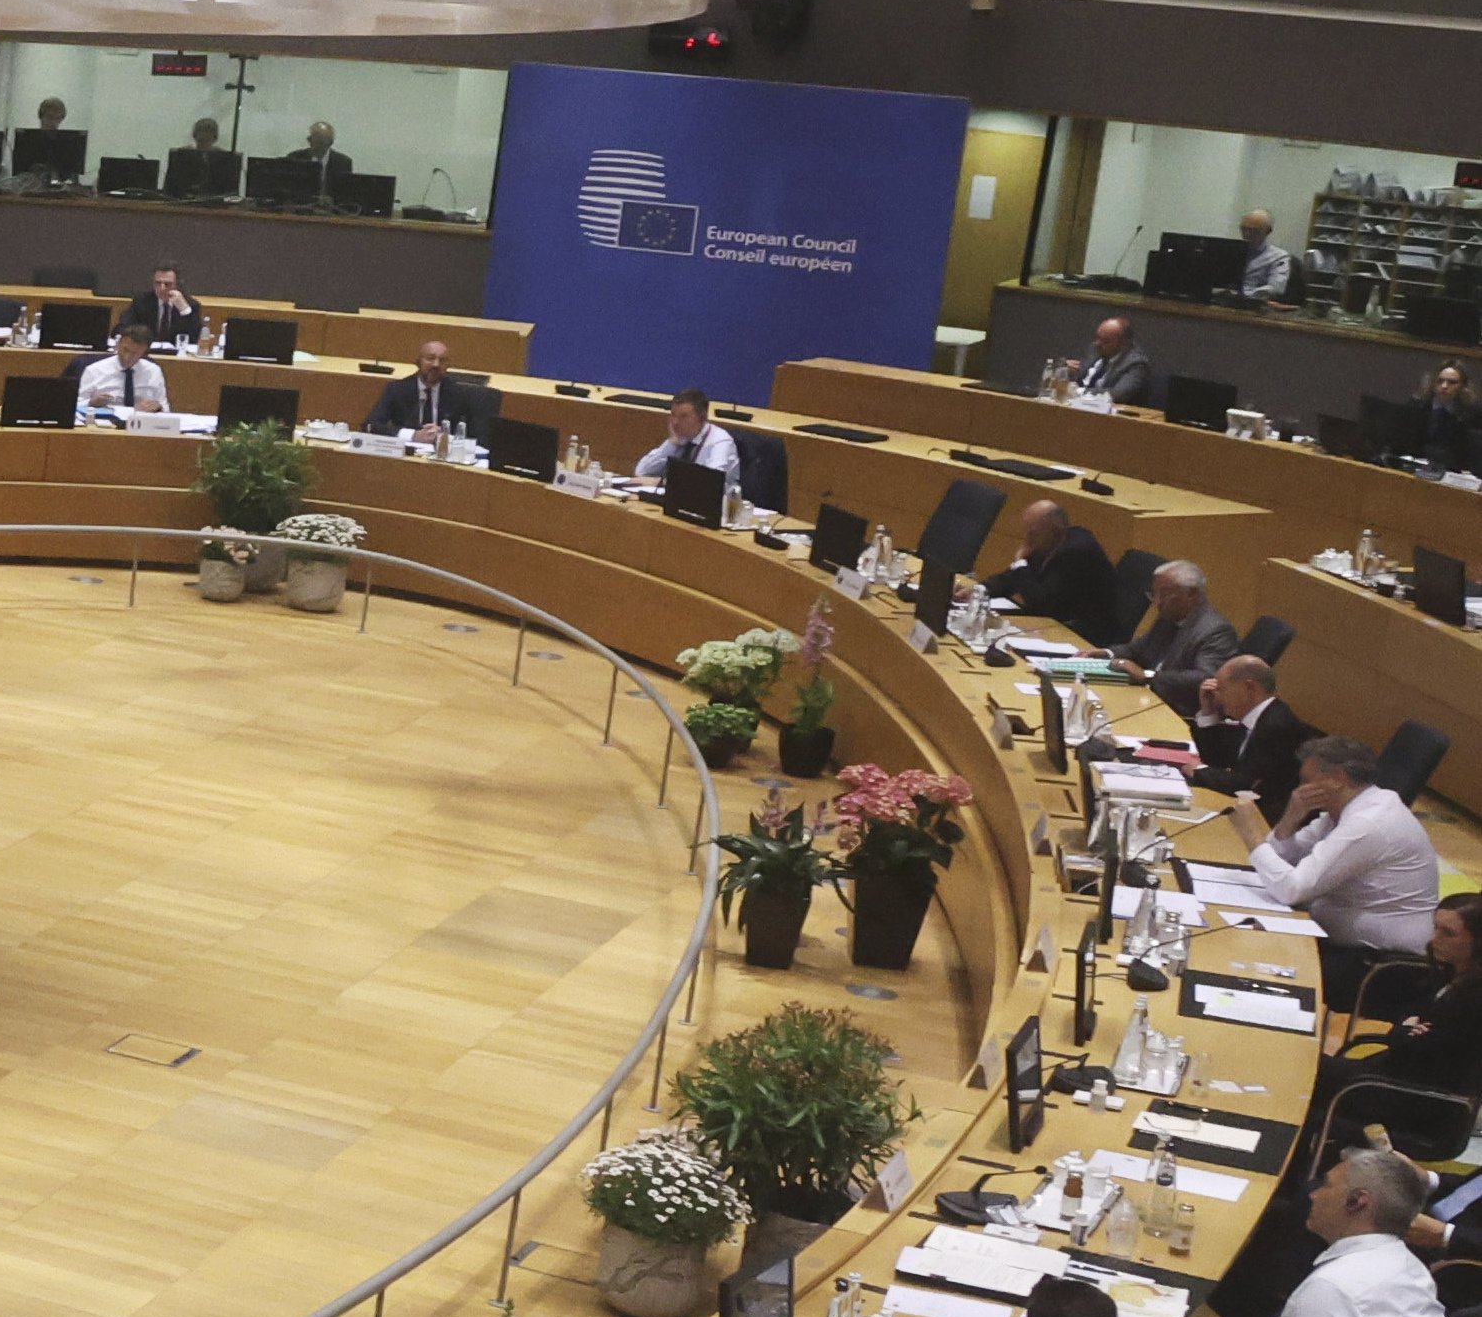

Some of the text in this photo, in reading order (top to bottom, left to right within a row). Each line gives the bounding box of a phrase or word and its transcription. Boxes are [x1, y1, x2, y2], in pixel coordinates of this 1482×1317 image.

[706, 225, 857, 254] European Council
[704, 244, 853, 273] Conseil européen
